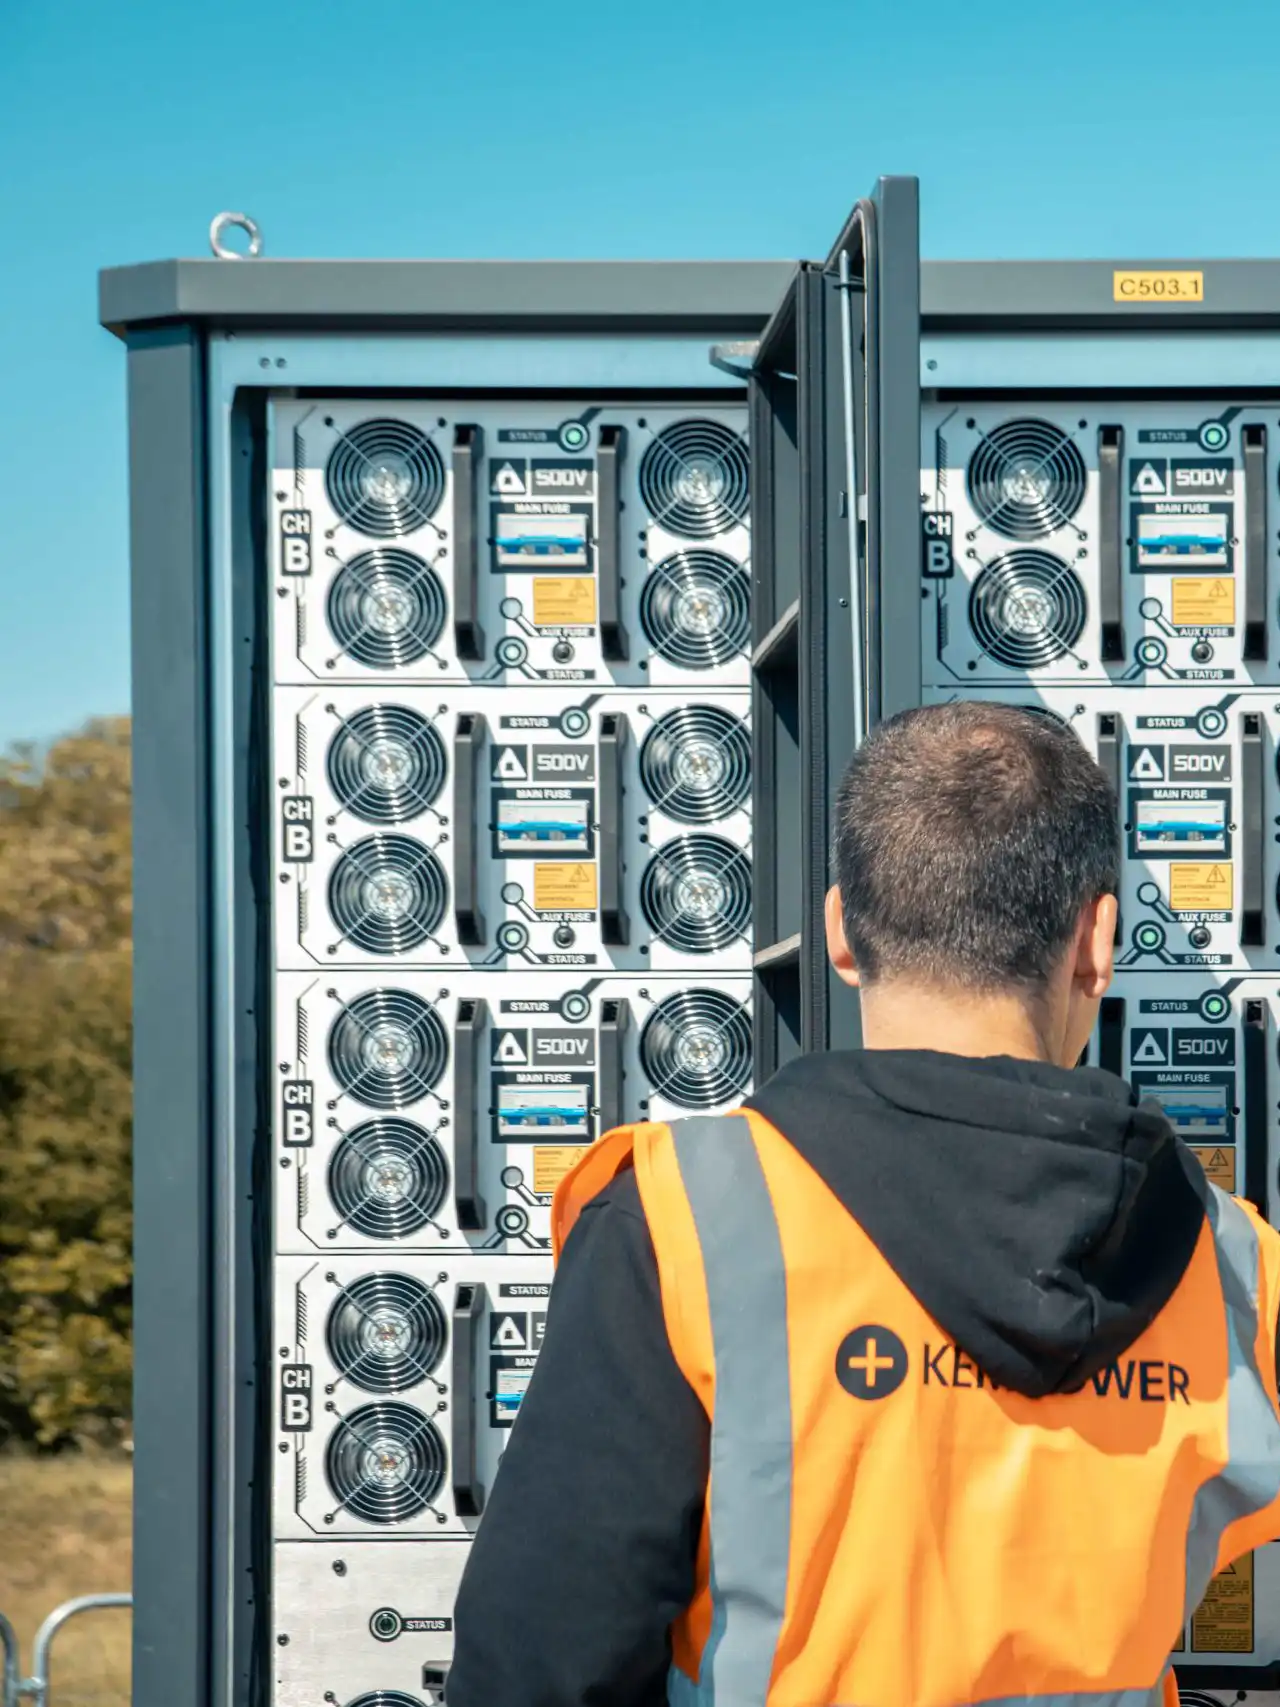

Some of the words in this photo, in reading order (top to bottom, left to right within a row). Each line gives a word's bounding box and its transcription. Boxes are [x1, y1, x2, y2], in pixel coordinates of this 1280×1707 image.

[1120, 278, 1199, 296] C503.1
[508, 431, 548, 442] STATUS
[1149, 431, 1188, 442] STATUS
[535, 468, 588, 486] 500V
[1176, 468, 1228, 486] 500V
[514, 503, 541, 513] MAIN
[542, 503, 571, 513] FUSE
[1155, 503, 1181, 513] MAIN
[1183, 503, 1210, 513] FUSE
[281, 513, 311, 534] CH
[924, 515, 952, 535] CH
[284, 537, 310, 571] B
[928, 541, 950, 572] B
[1180, 627, 1200, 637] AUX
[1203, 627, 1229, 637] FUSE
[546, 669, 586, 680] STATUS
[1185, 669, 1224, 679] STATUS
[509, 717, 549, 728] STATUS
[1147, 717, 1185, 728] STATUS
[536, 754, 589, 771] 500V
[1173, 754, 1226, 772] 500V
[516, 789, 542, 799] MAIN
[544, 789, 572, 799] FUSE
[1153, 789, 1179, 799] MAIN
[1181, 789, 1208, 799] FUSE
[283, 799, 312, 820] CH
[286, 823, 311, 857] B
[540, 912, 562, 921] AUX
[563, 912, 591, 921] FUSE
[1178, 912, 1199, 921] AUX
[1201, 912, 1227, 921] FUSE
[546, 954, 587, 964] STATUS
[1184, 954, 1221, 964] STATUS
[510, 1001, 550, 1011] STATUS
[1151, 1002, 1188, 1011] STATUS
[536, 1038, 589, 1055] 500V
[1178, 1039, 1229, 1055] 500V
[516, 1073, 543, 1083] MAIN
[544, 1073, 572, 1083] FUSE
[1157, 1074, 1182, 1083] MAIN
[1184, 1074, 1211, 1083] FUSE
[284, 1085, 312, 1105] CH
[286, 1108, 312, 1141] B
[508, 1285, 549, 1295] STATUS
[282, 1370, 311, 1388] CH
[923, 1343, 1190, 1405] KEWER
[285, 1394, 310, 1426] B
[406, 1620, 446, 1630] STATUS
